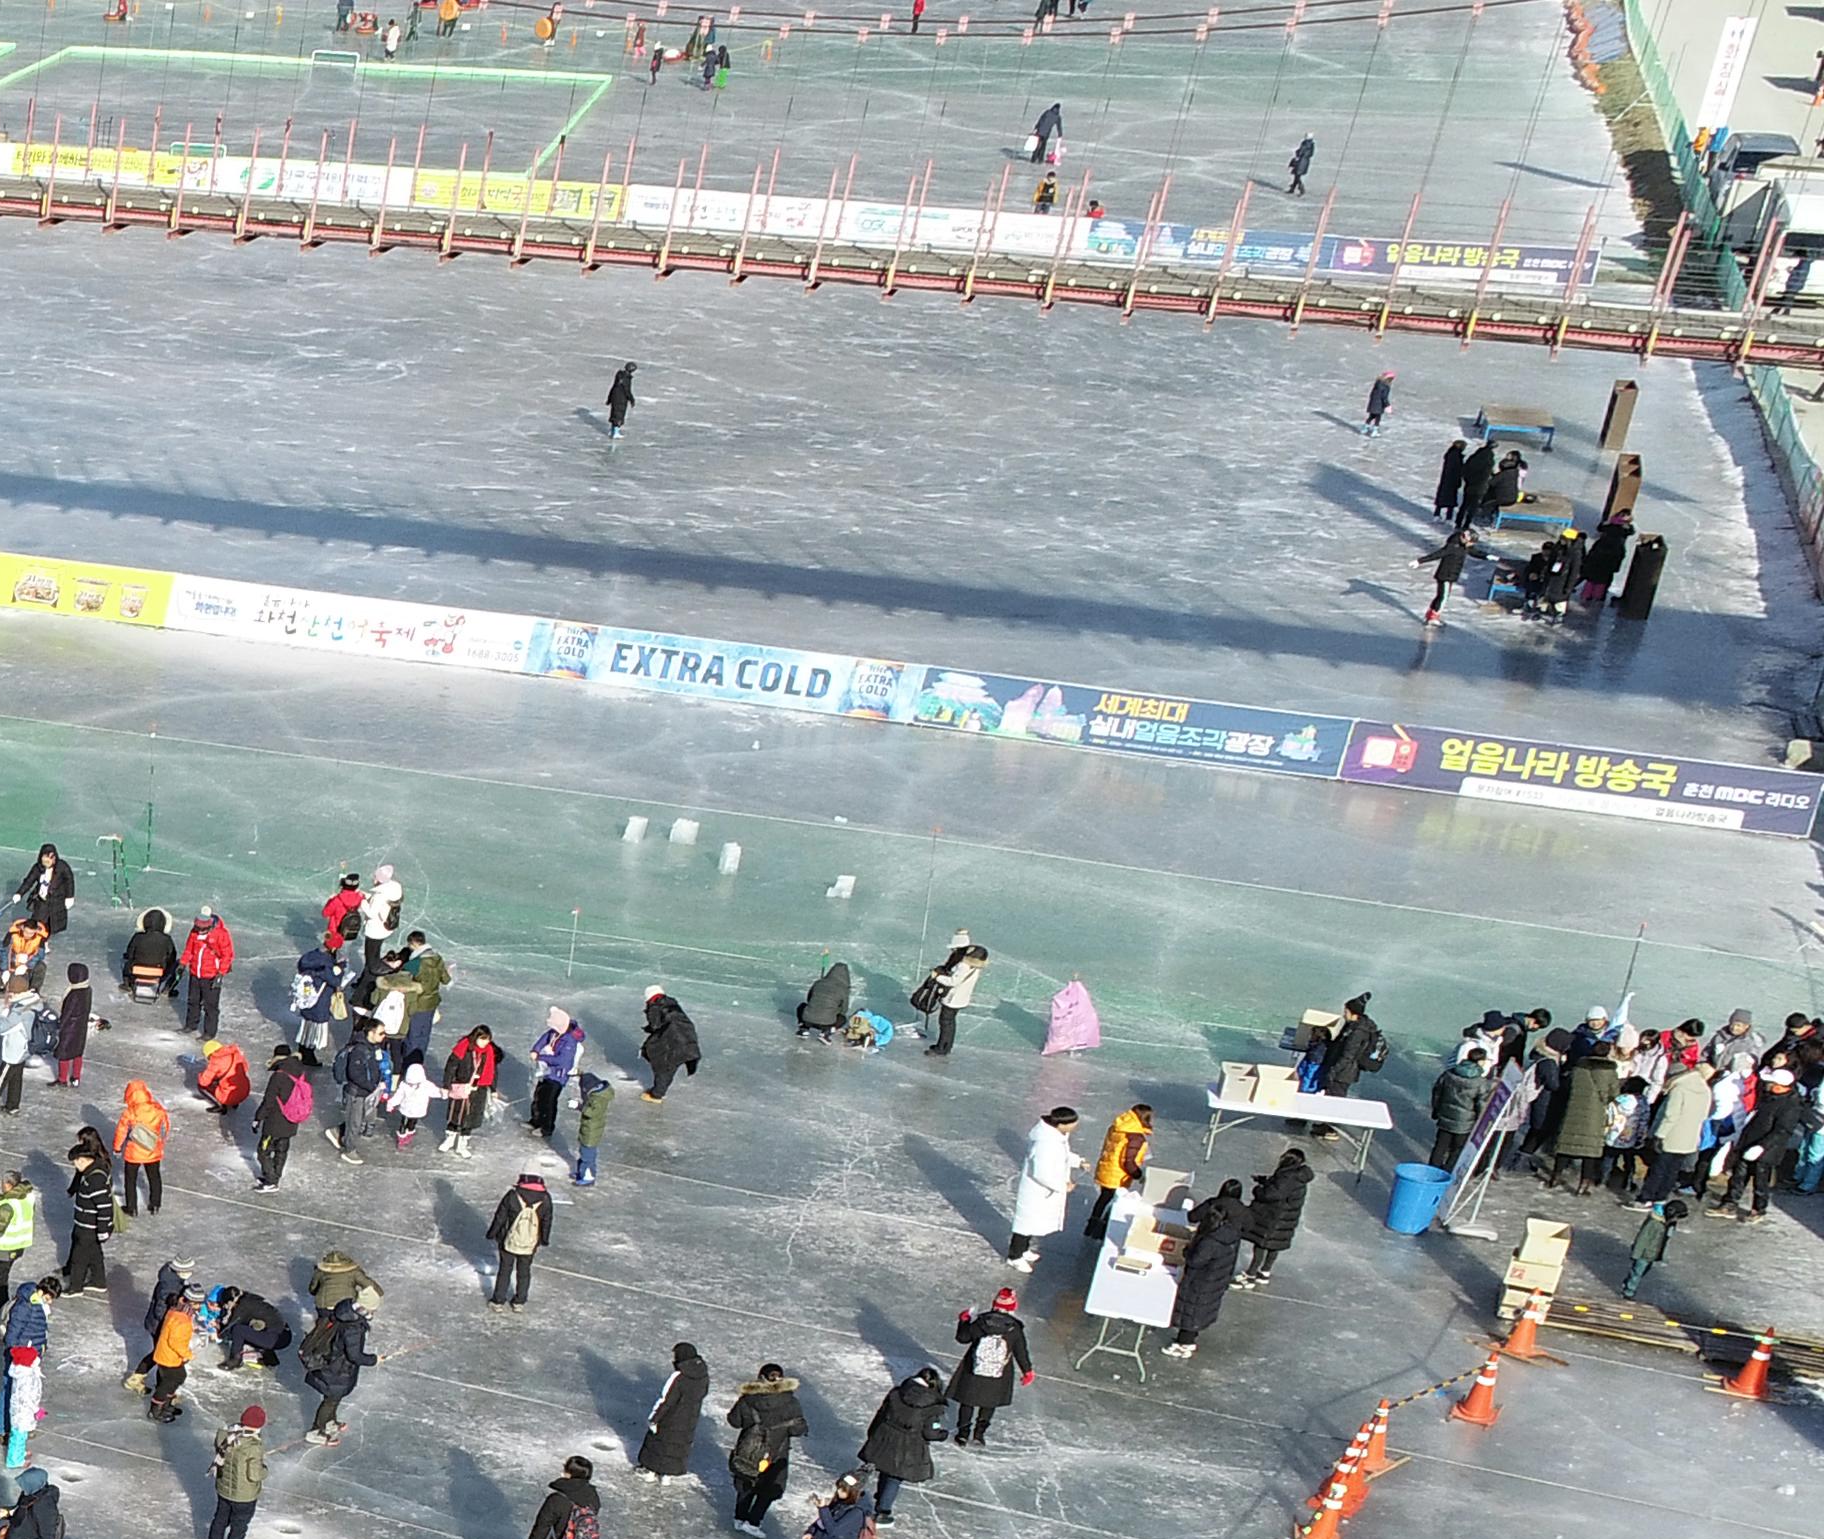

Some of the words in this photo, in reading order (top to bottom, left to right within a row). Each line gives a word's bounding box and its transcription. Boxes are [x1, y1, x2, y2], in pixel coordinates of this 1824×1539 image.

[555, 634, 591, 651] EXTRA
[466, 647, 520, 664] 1688-3005
[555, 645, 586, 660] COLD
[610, 641, 726, 688] EXTRA
[735, 659, 832, 700] COLD
[857, 672, 895, 690] EXTRA
[857, 684, 889, 699] COLD
[1092, 692, 1191, 724] 세계최대
[1089, 715, 1276, 757] 실내얼음조각광장
[1439, 736, 1571, 785] 얼음나라
[1574, 752, 1680, 798] 방송국
[1682, 781, 1714, 801] 춘천
[1714, 785, 1766, 807] MBC
[1766, 789, 1812, 811] 라디오
